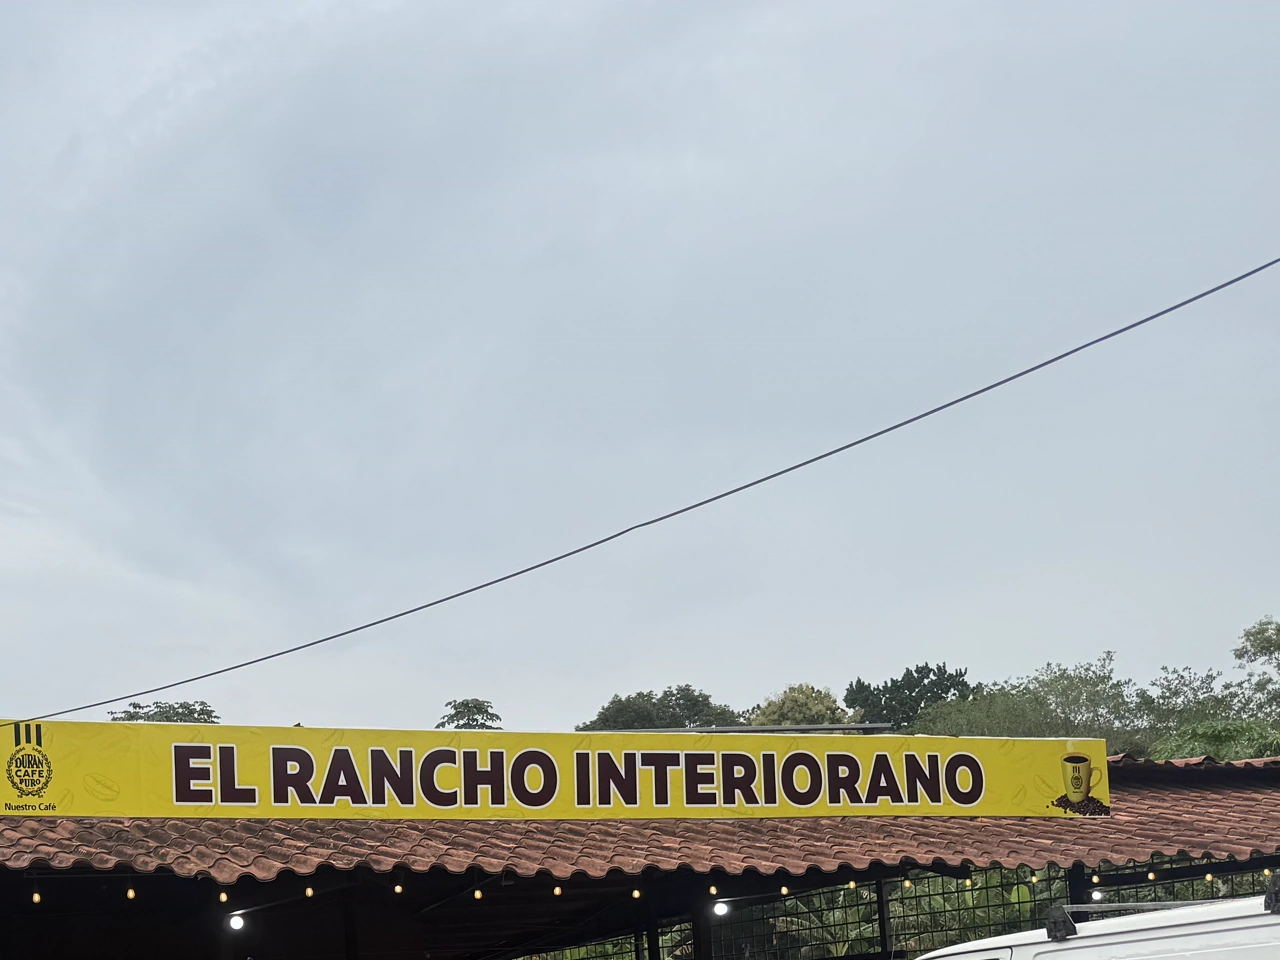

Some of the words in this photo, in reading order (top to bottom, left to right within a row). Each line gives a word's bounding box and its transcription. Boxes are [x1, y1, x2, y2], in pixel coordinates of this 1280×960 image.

[15, 769, 44, 778] CAFE
[173, 745, 257, 804] EL
[271, 746, 558, 807] RANCHO
[575, 750, 984, 806] INTERIORANO
[19, 778, 41, 788] PURO
[4, 802, 37, 811] Nuestro
[38, 802, 57, 811] Café
